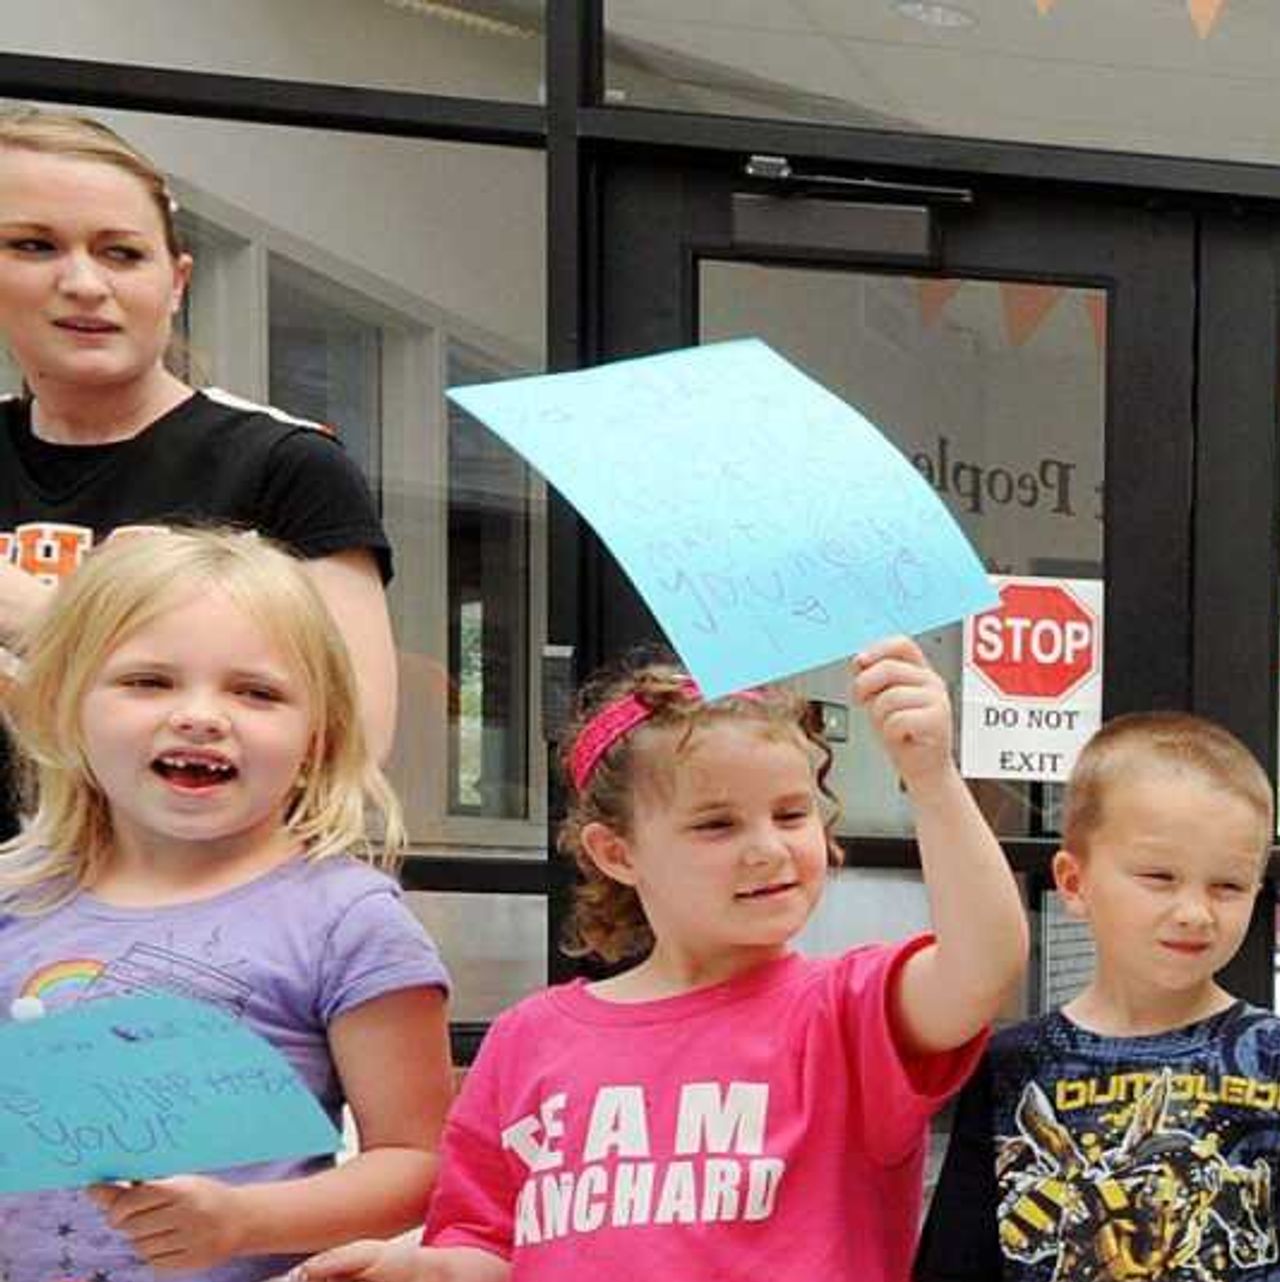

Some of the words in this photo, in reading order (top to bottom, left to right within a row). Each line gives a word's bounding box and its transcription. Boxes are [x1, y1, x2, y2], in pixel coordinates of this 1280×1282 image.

[975, 617, 1092, 666] STOP
[984, 708, 1023, 728] DO
[1028, 710, 1080, 731] NOT
[1000, 753, 1064, 773] EXIT
[514, 1157, 785, 1247] ANCHARD
